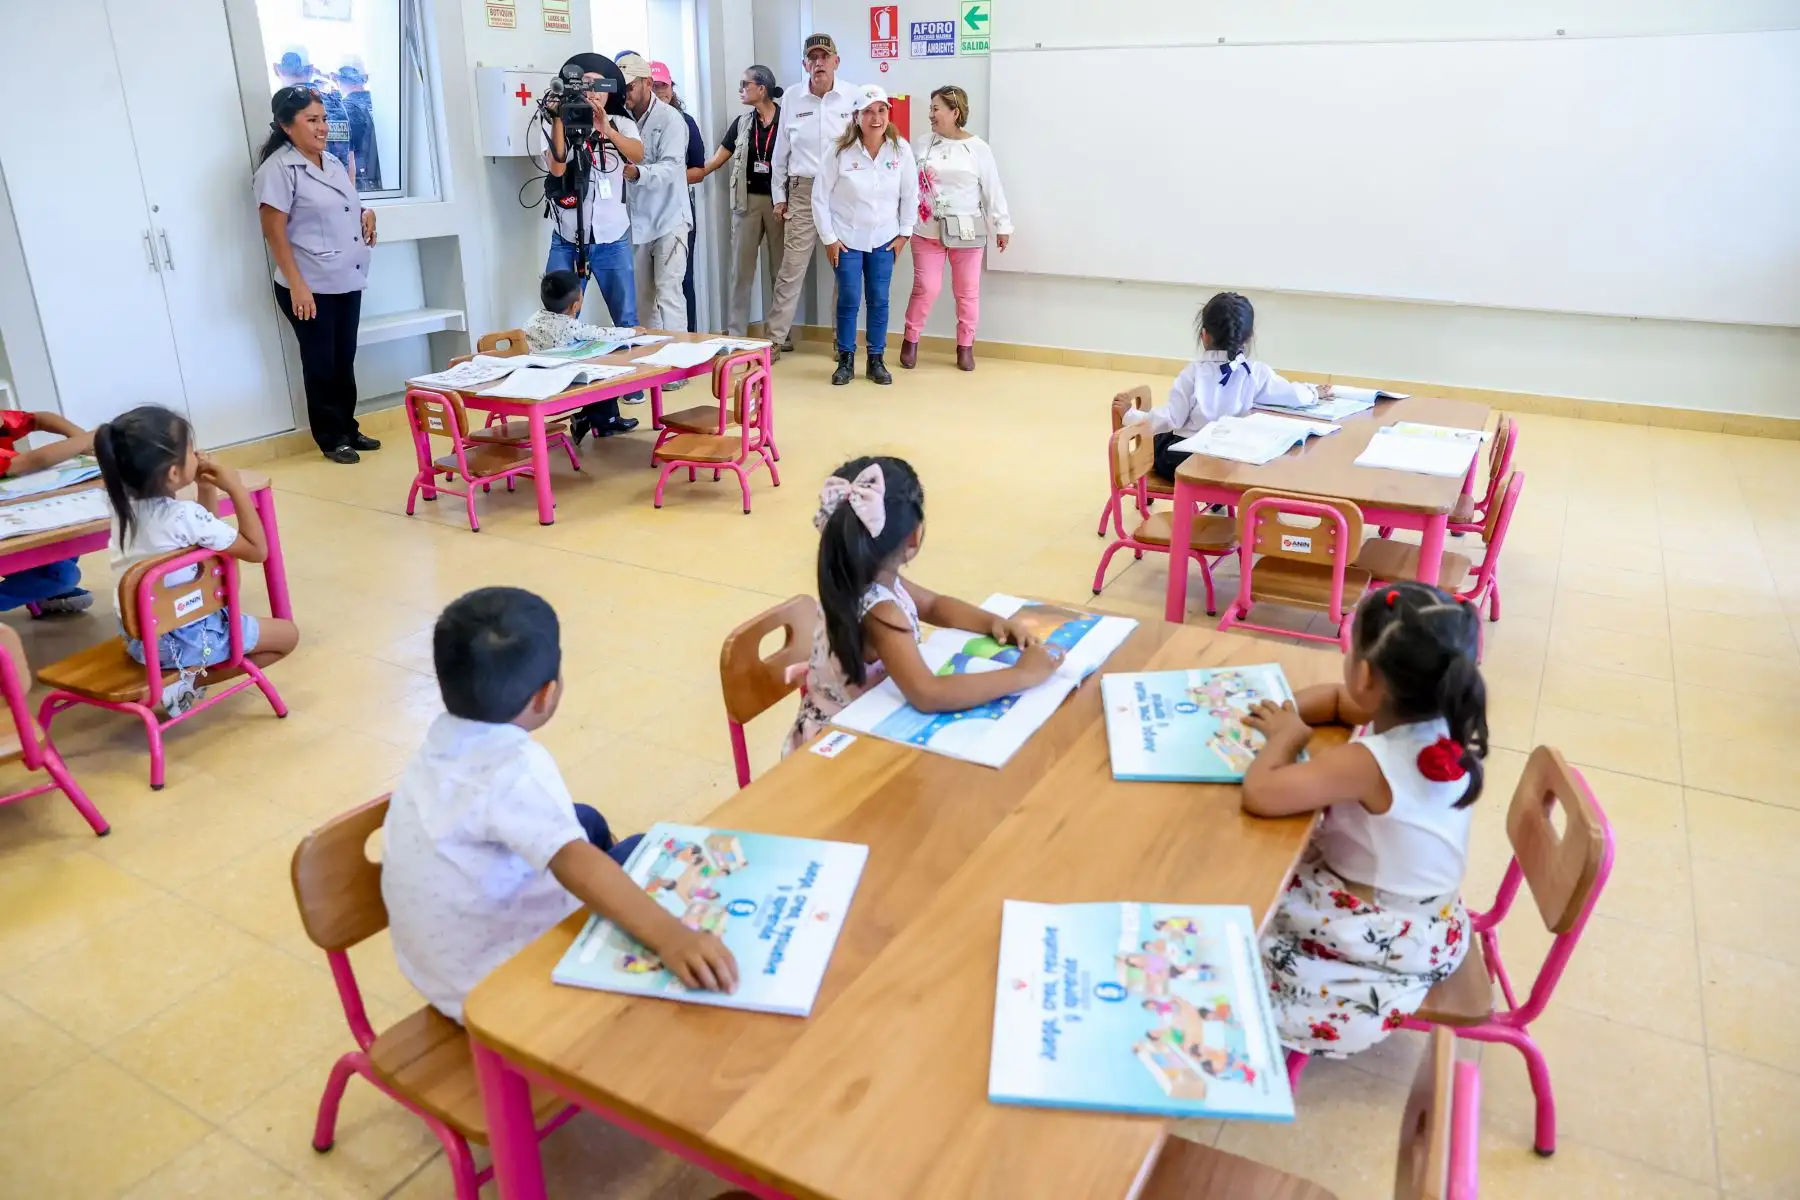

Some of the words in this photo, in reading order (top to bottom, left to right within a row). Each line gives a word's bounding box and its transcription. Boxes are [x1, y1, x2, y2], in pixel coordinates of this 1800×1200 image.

[913, 22, 953, 34] AFORO
[927, 42, 954, 54] AMBIENTE
[962, 41, 989, 50] SALIDA
[185, 595, 201, 607] ANIN
